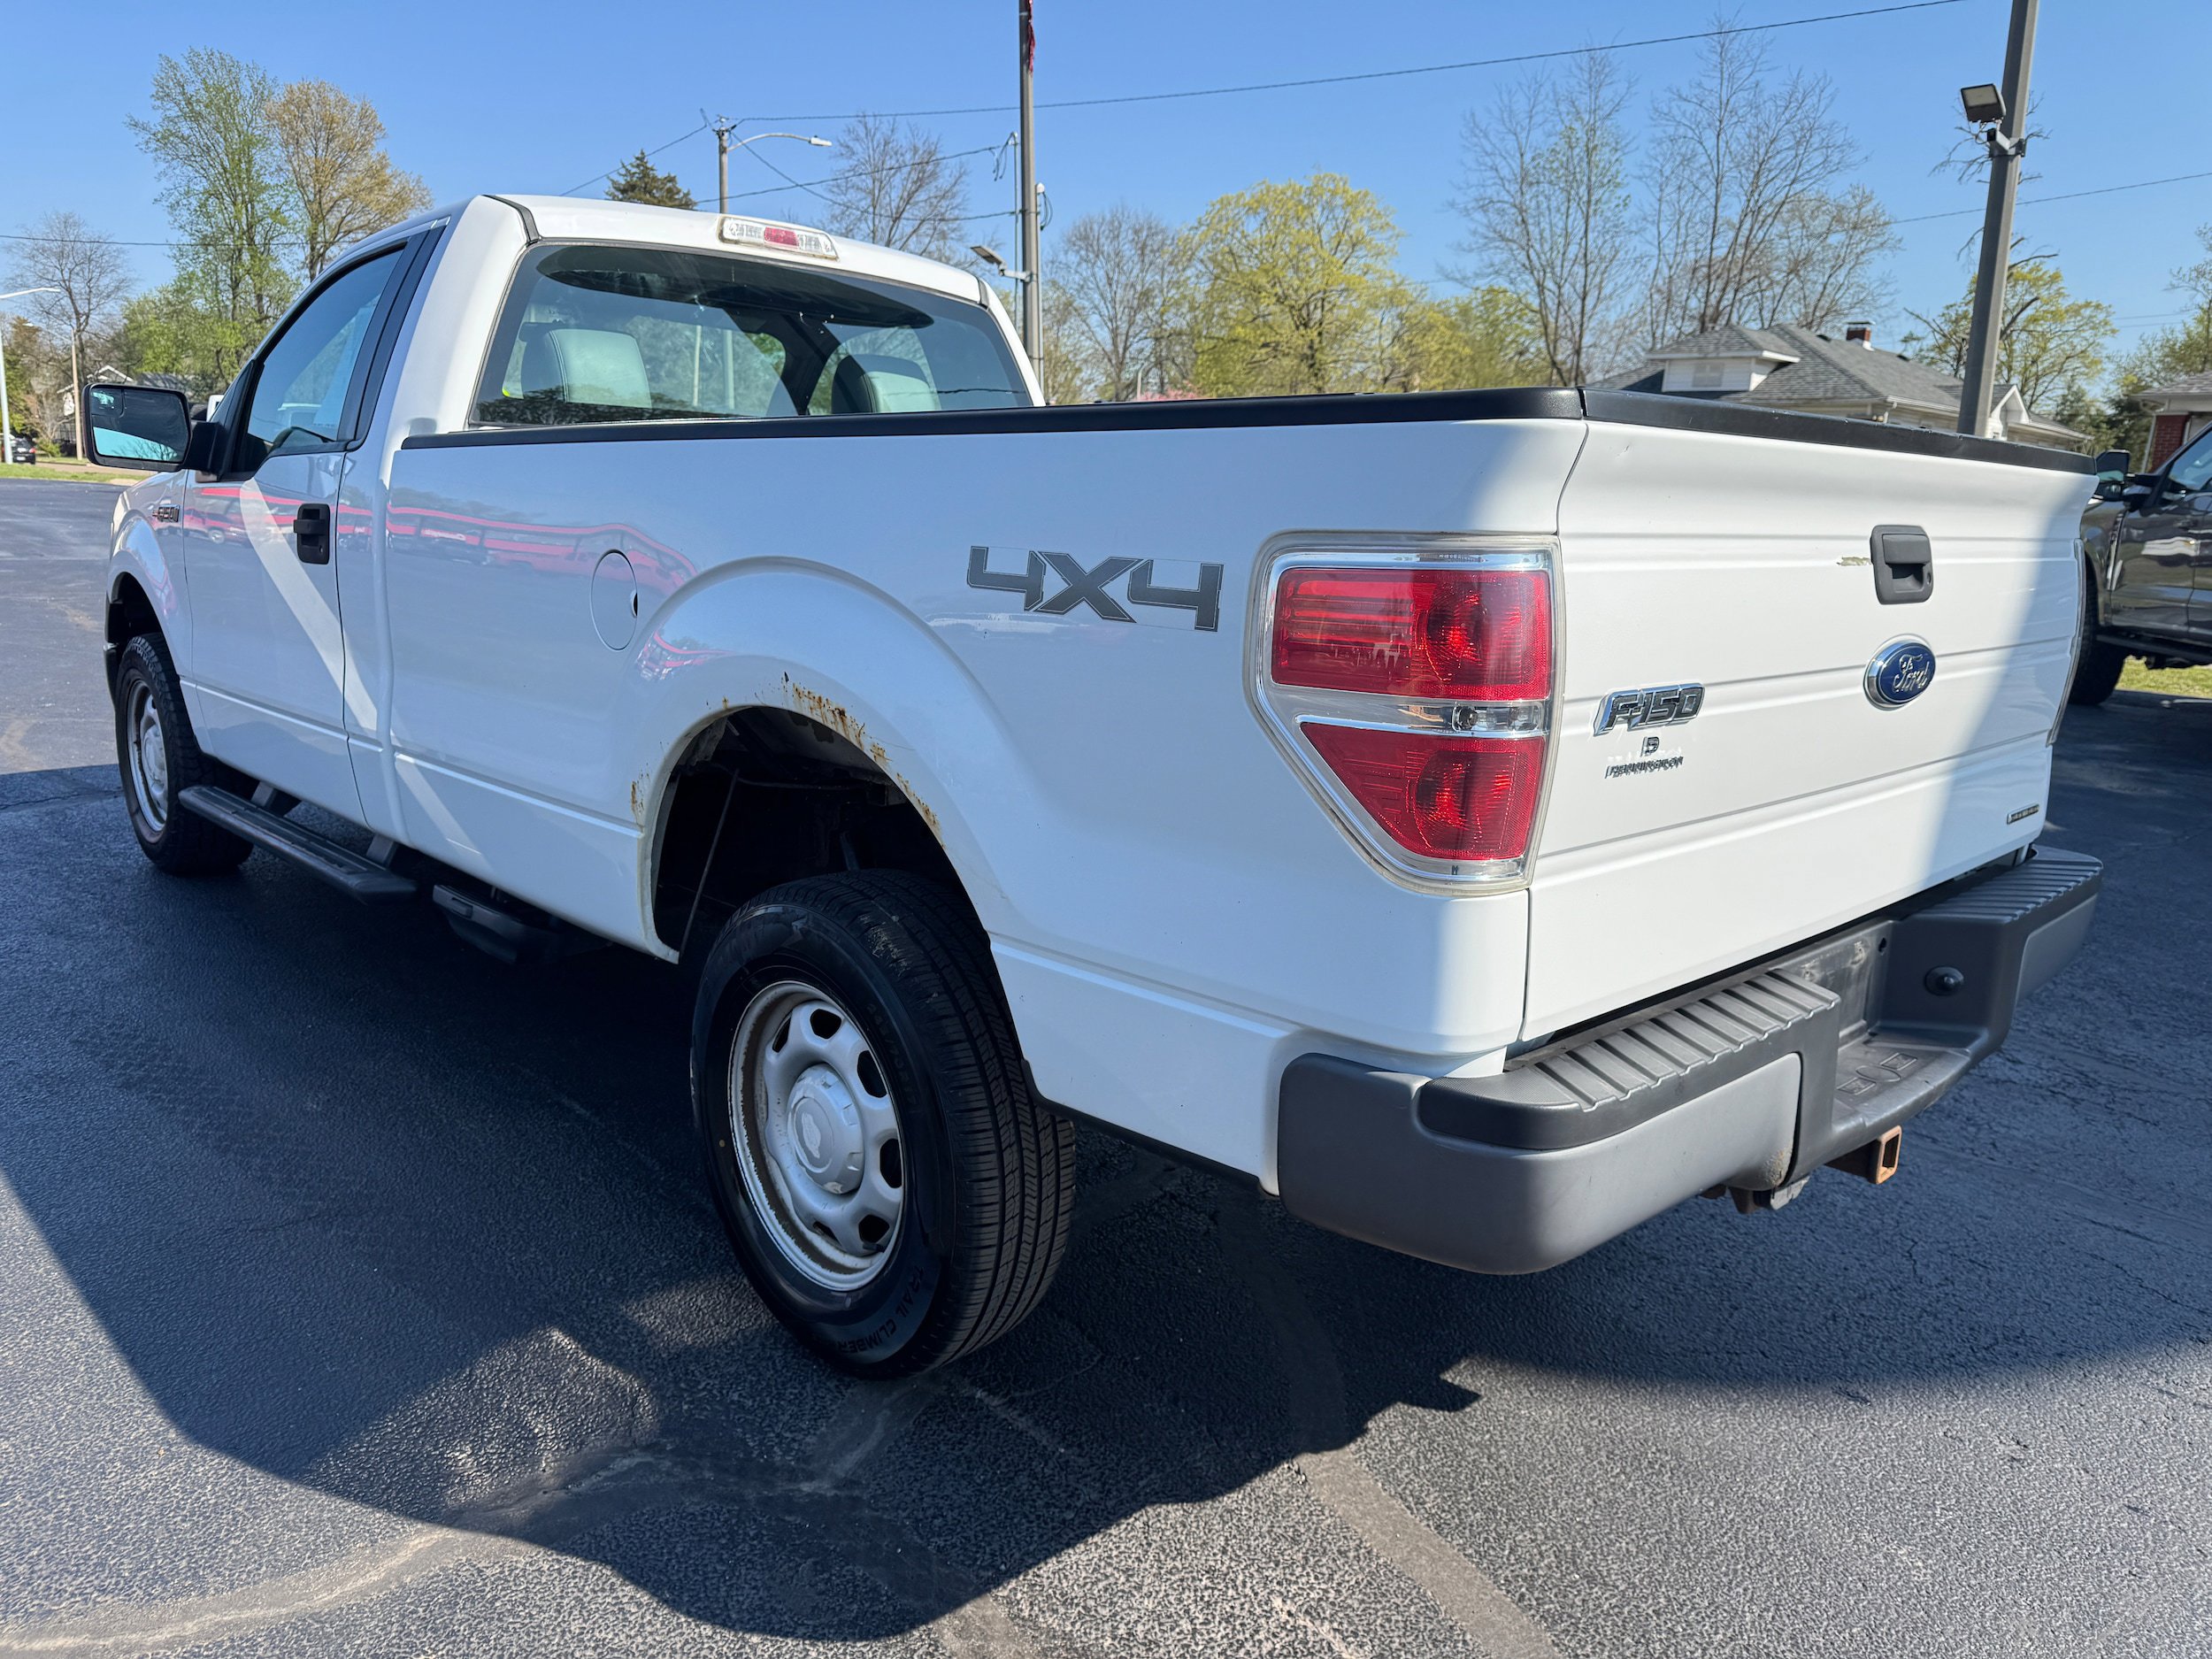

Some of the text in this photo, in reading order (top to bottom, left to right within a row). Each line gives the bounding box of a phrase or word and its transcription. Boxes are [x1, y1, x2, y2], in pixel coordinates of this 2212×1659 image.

[1893, 653, 1931, 693] Ford
[1594, 683, 1705, 736] F-150
[837, 1265, 925, 1354] TRAIL CLIMBER
